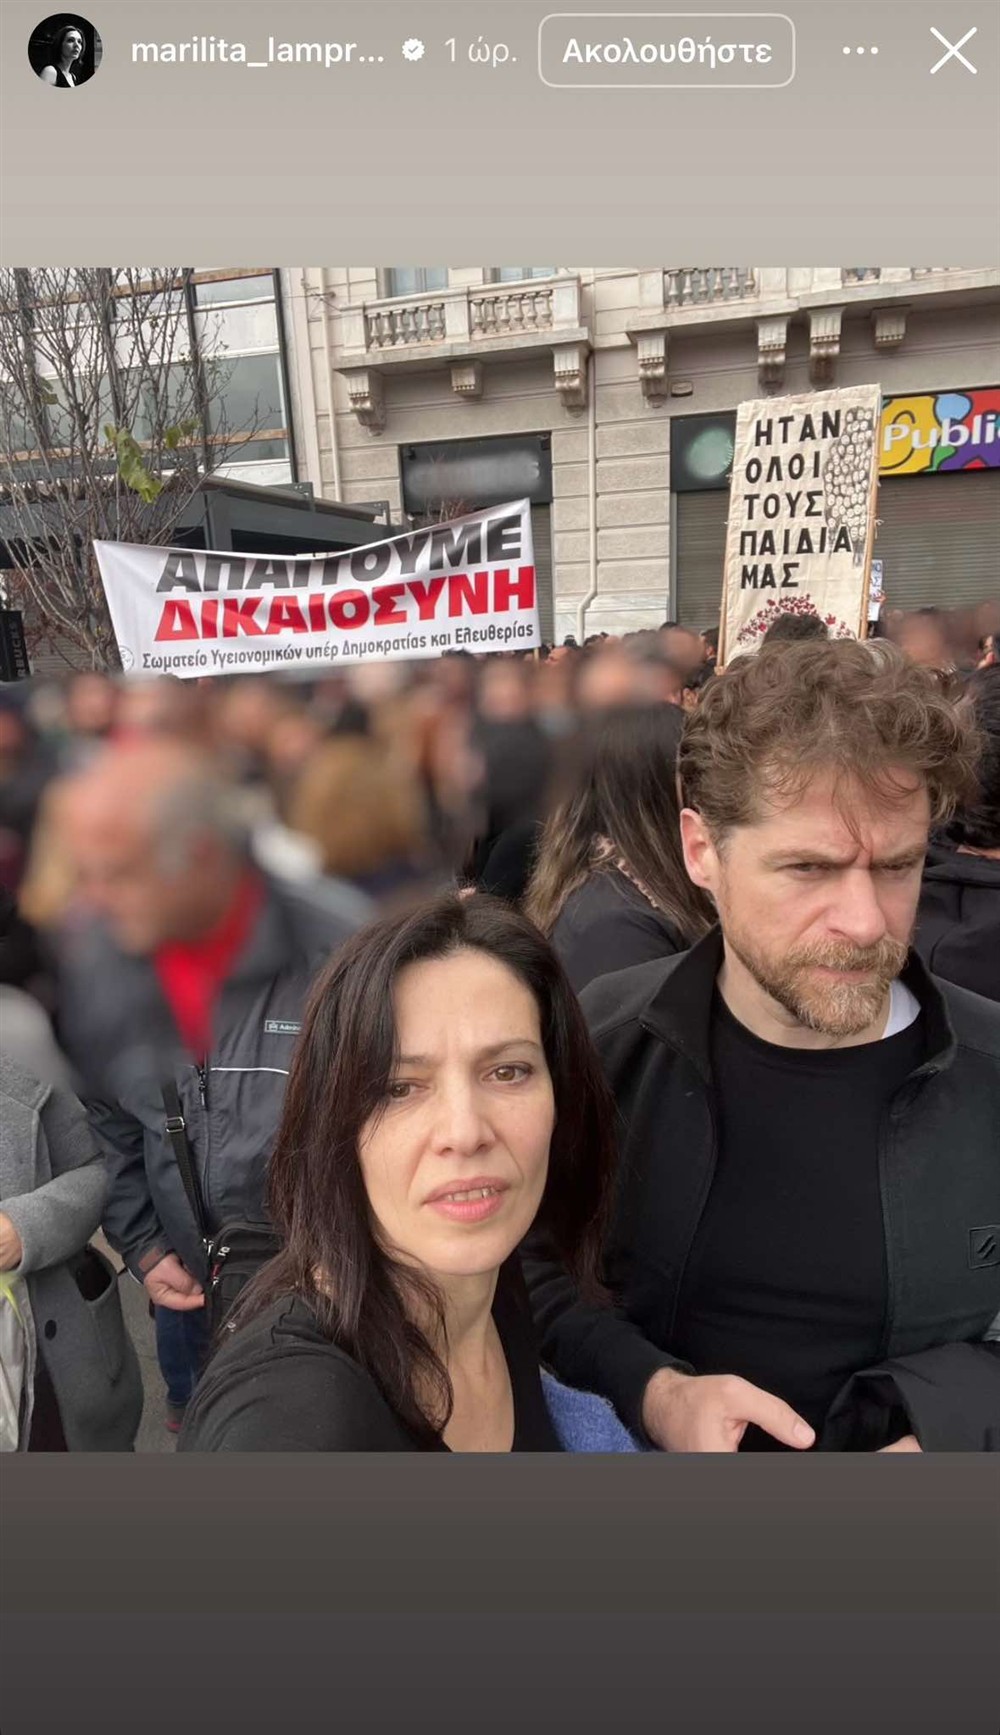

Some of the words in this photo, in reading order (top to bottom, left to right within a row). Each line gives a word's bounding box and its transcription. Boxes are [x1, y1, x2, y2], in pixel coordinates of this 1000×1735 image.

[754, 410, 842, 447] ΗΤΑΝ
[883, 413, 1000, 452] Publi
[745, 451, 821, 484] ΟΛΟΙ
[744, 490, 824, 521] ΤΟΥΣ
[156, 514, 521, 593] ΑΠΑΙΤΟΥΜΕ
[739, 526, 852, 557] ΠΑΙΔΙΑ
[740, 562, 800, 590] ΜΑΣ
[154, 566, 535, 642] ΔΙΚΑΙΟΣΥΝΗ
[142, 648, 208, 672] Σωματείο
[211, 643, 302, 669] Υγειονομικών
[306, 641, 338, 662] υπέρ
[342, 632, 427, 658] Δημοκρατίας
[431, 633, 450, 648] και
[455, 620, 534, 644] Ελευθερίας
